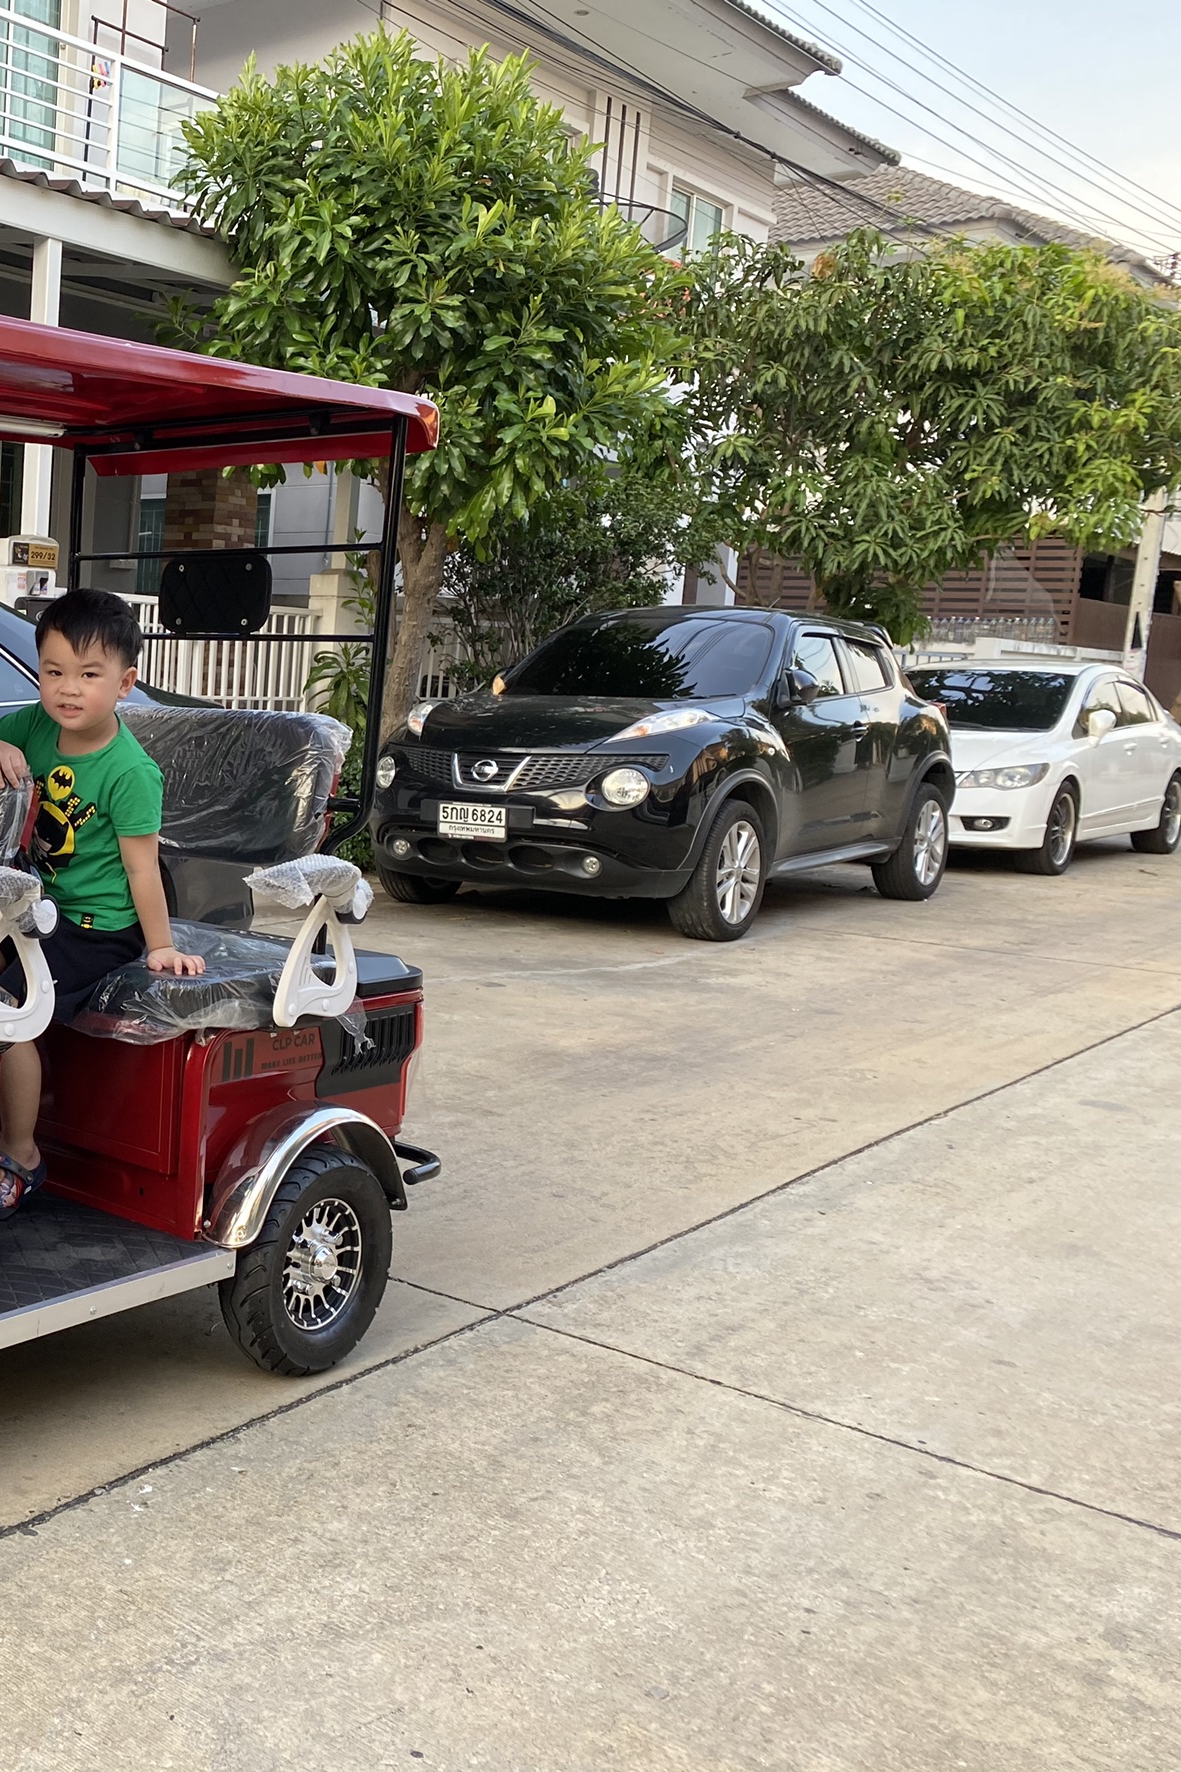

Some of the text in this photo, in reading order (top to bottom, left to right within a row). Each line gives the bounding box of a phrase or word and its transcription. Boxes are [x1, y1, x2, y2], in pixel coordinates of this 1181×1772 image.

[30, 551, 56, 561] 299/32
[442, 806, 503, 824] 5กญ 6824
[448, 824, 495, 835] กรุงเทพมหานคร
[272, 1033, 315, 1051] CLP CAR
[261, 1060, 280, 1070] MAKE
[282, 1056, 296, 1066] LIFE
